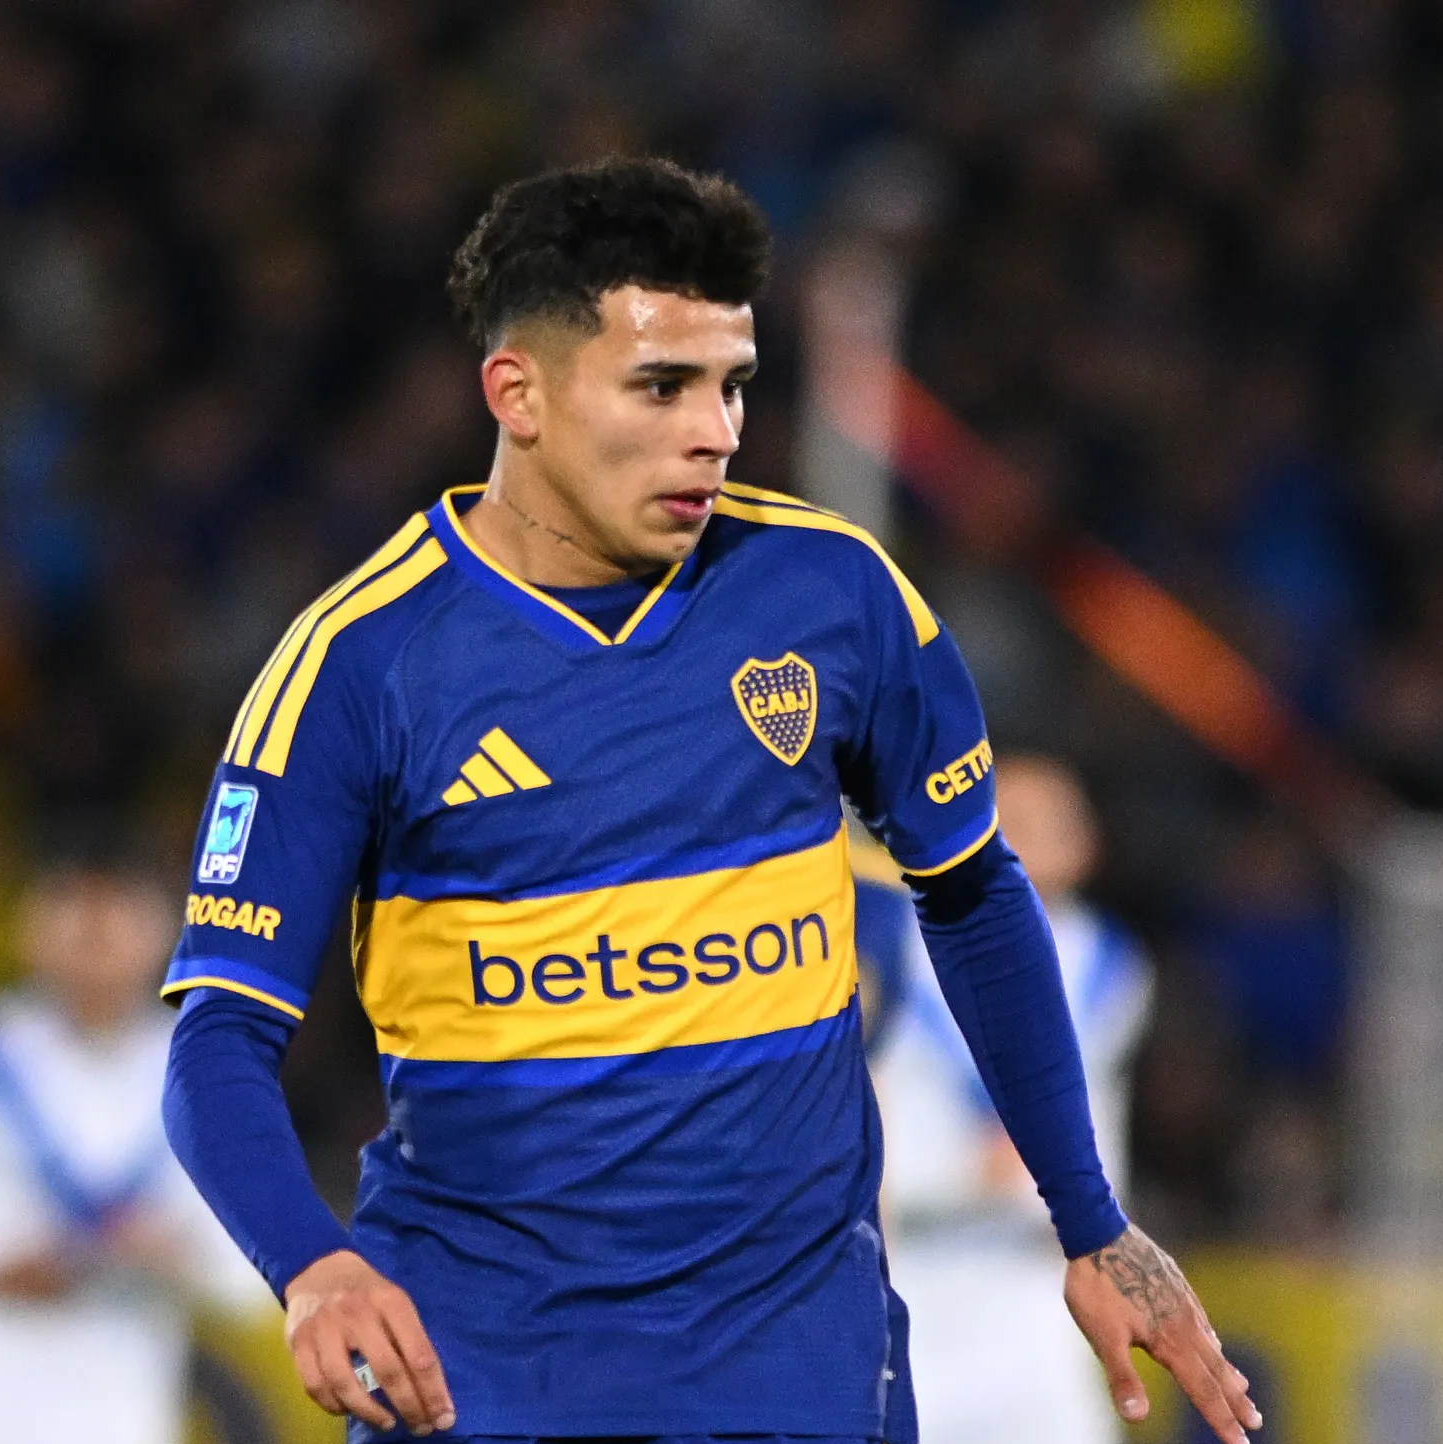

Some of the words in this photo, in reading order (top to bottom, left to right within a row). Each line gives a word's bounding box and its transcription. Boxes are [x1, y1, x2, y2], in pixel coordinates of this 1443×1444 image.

[749, 688, 810, 718] CABJ
[199, 854, 239, 879] LPF
[468, 912, 829, 1007] betsson
